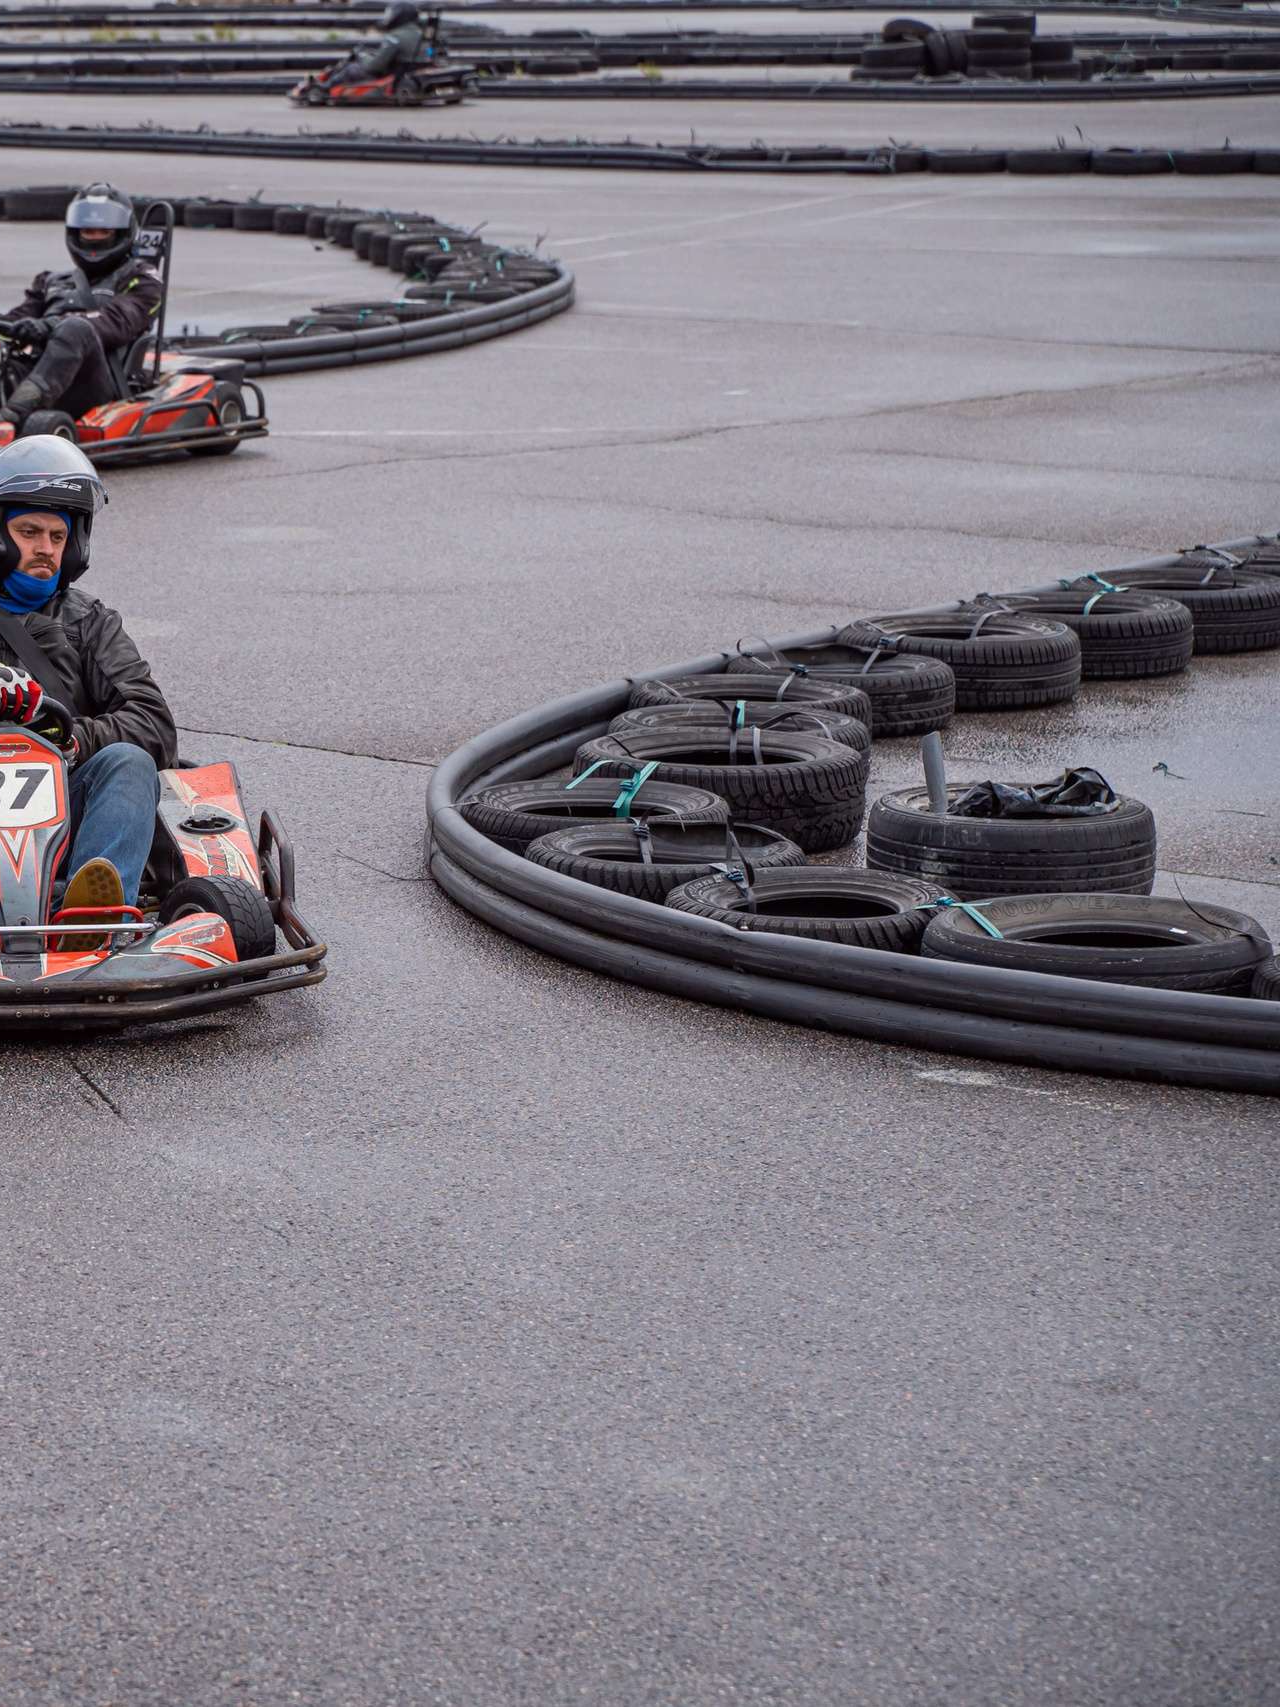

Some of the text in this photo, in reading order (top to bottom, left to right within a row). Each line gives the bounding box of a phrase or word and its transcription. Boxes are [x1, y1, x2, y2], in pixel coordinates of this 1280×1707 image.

[140, 234, 162, 249] 24
[1066, 895, 1152, 911] YEAR
[180, 926, 224, 944] DINO
